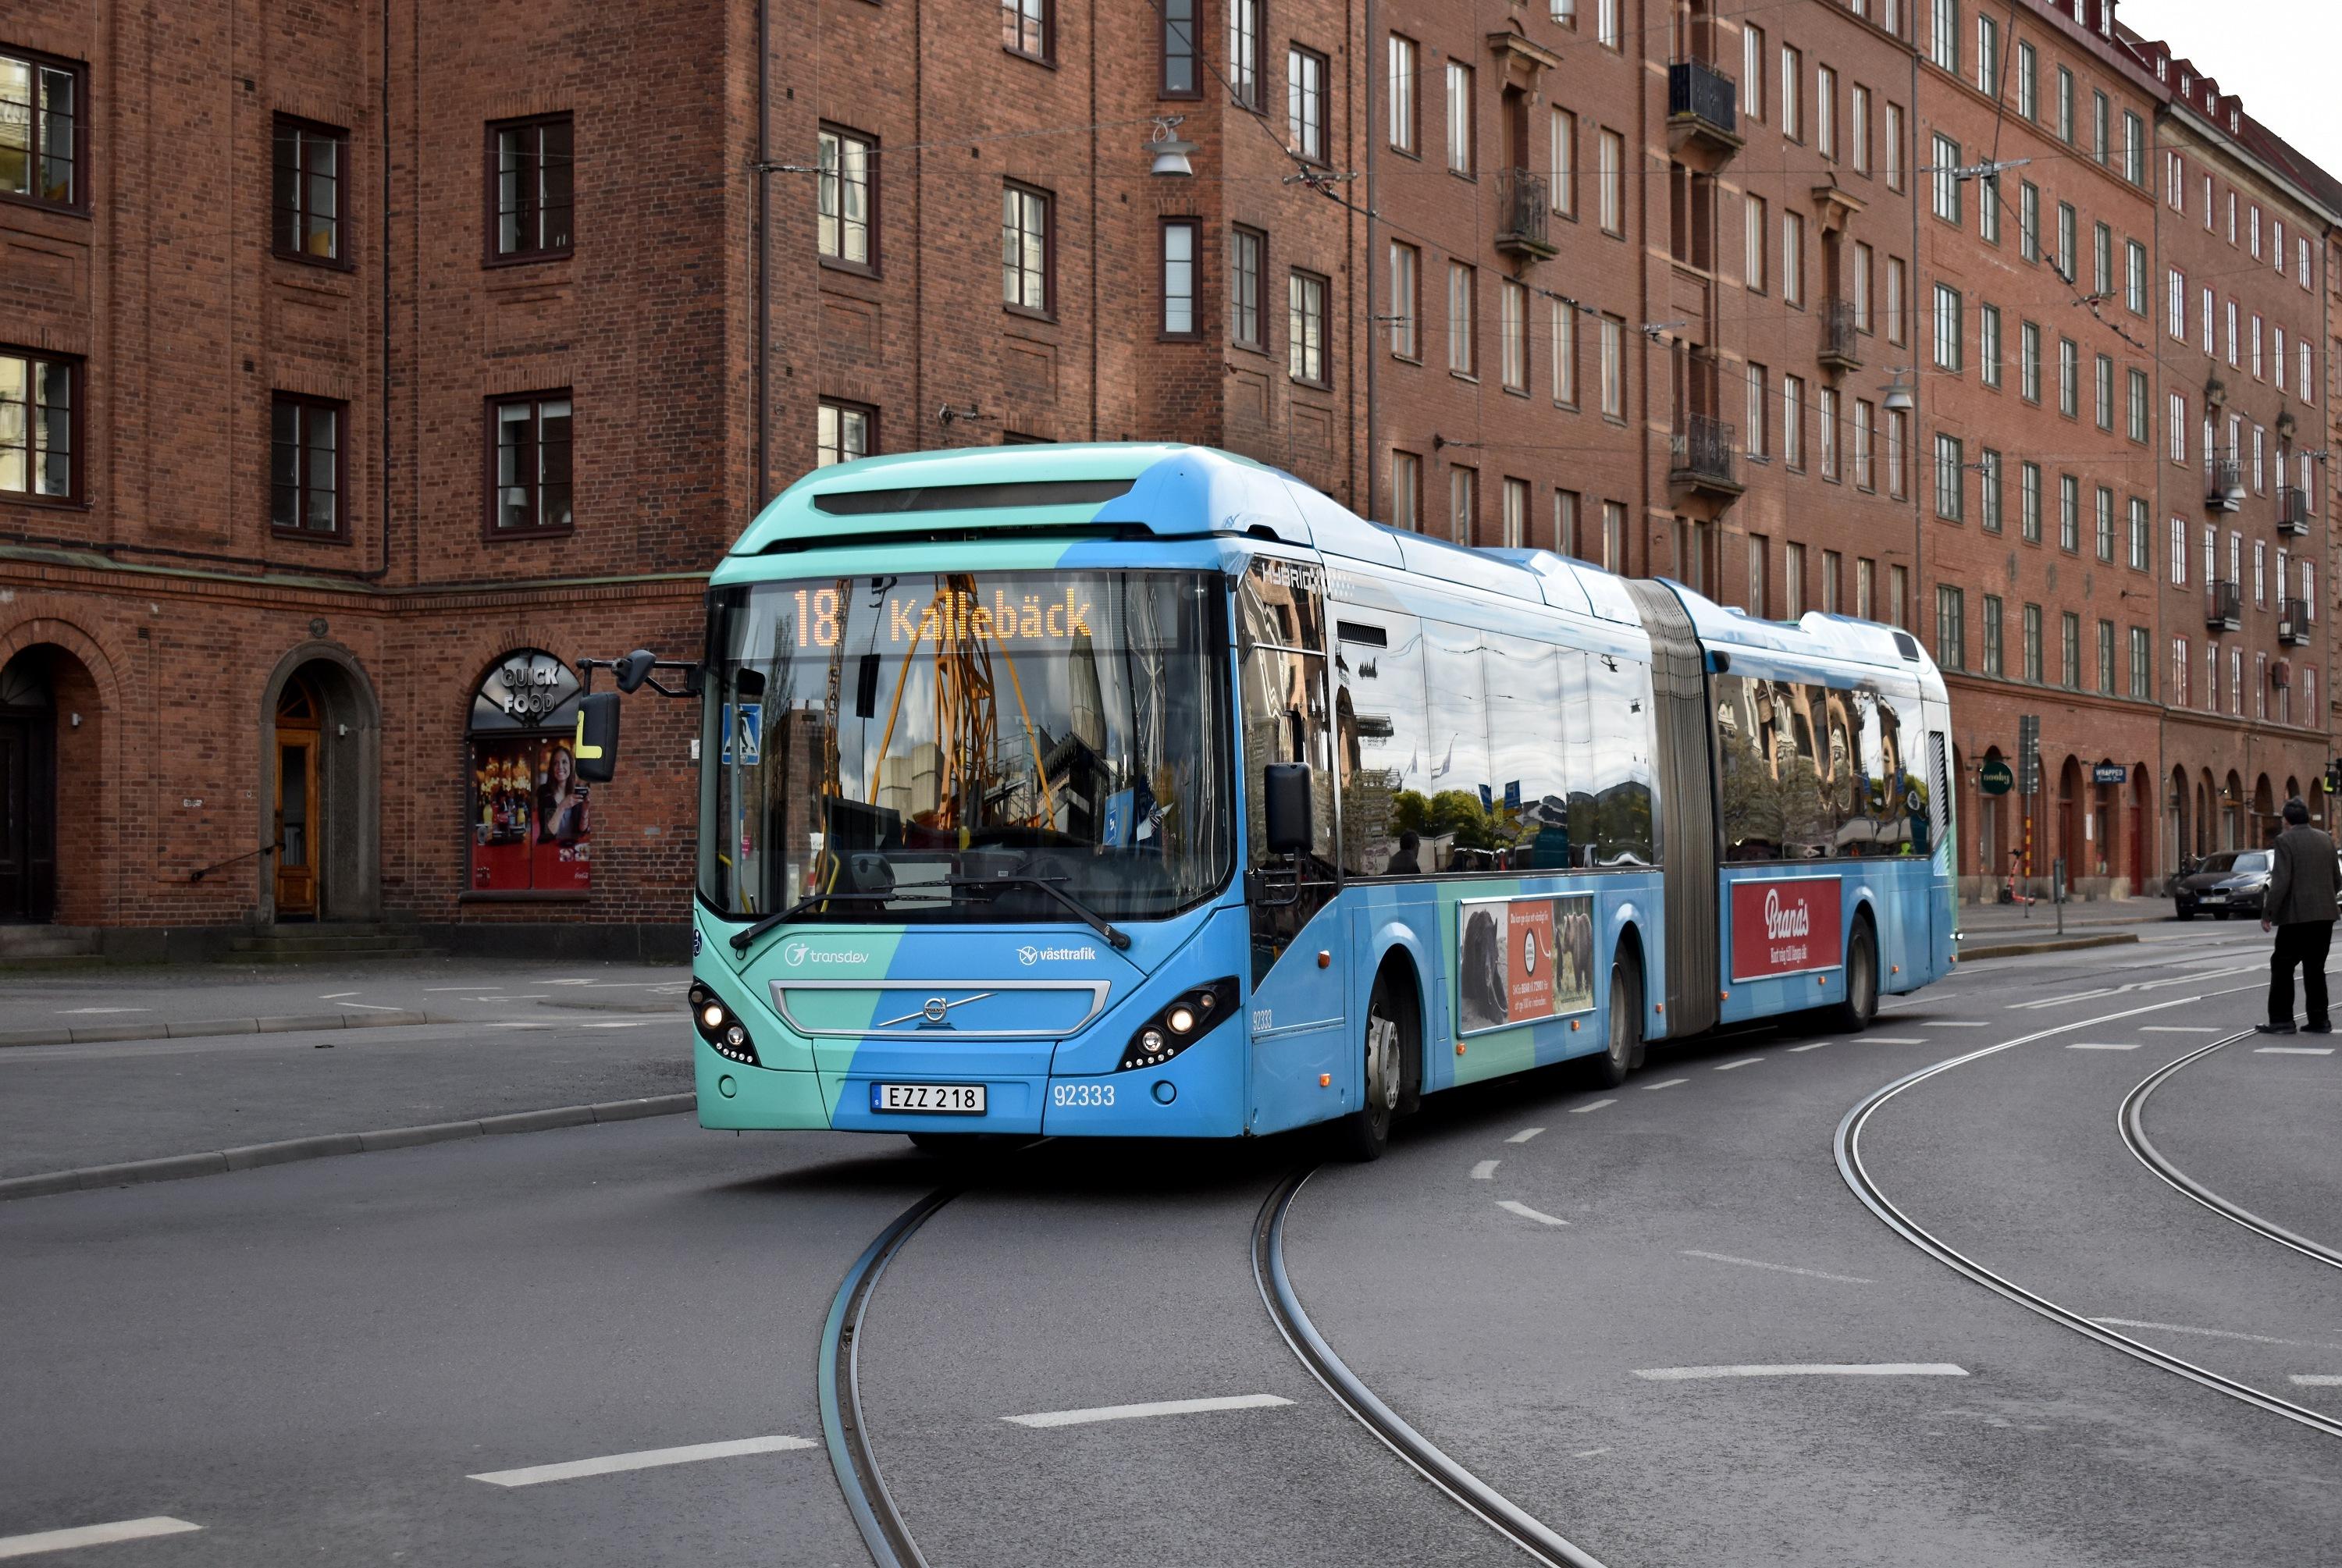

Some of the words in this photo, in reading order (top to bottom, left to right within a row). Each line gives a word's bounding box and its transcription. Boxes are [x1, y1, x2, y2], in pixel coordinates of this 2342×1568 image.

[1262, 563, 1312, 590] HYBRID
[794, 589, 840, 647] 18
[891, 588, 1092, 642] Kallebäck
[501, 667, 559, 686] QUICK
[504, 694, 556, 713] FOOD
[1764, 888, 1809, 940] Branäs
[810, 950, 870, 963] transdev
[1039, 947, 1096, 961] västtrafik
[1253, 1009, 1272, 1030] 92333
[889, 1087, 928, 1108] EZZ
[935, 1088, 976, 1108] 218
[1054, 1085, 1116, 1107] 92333
